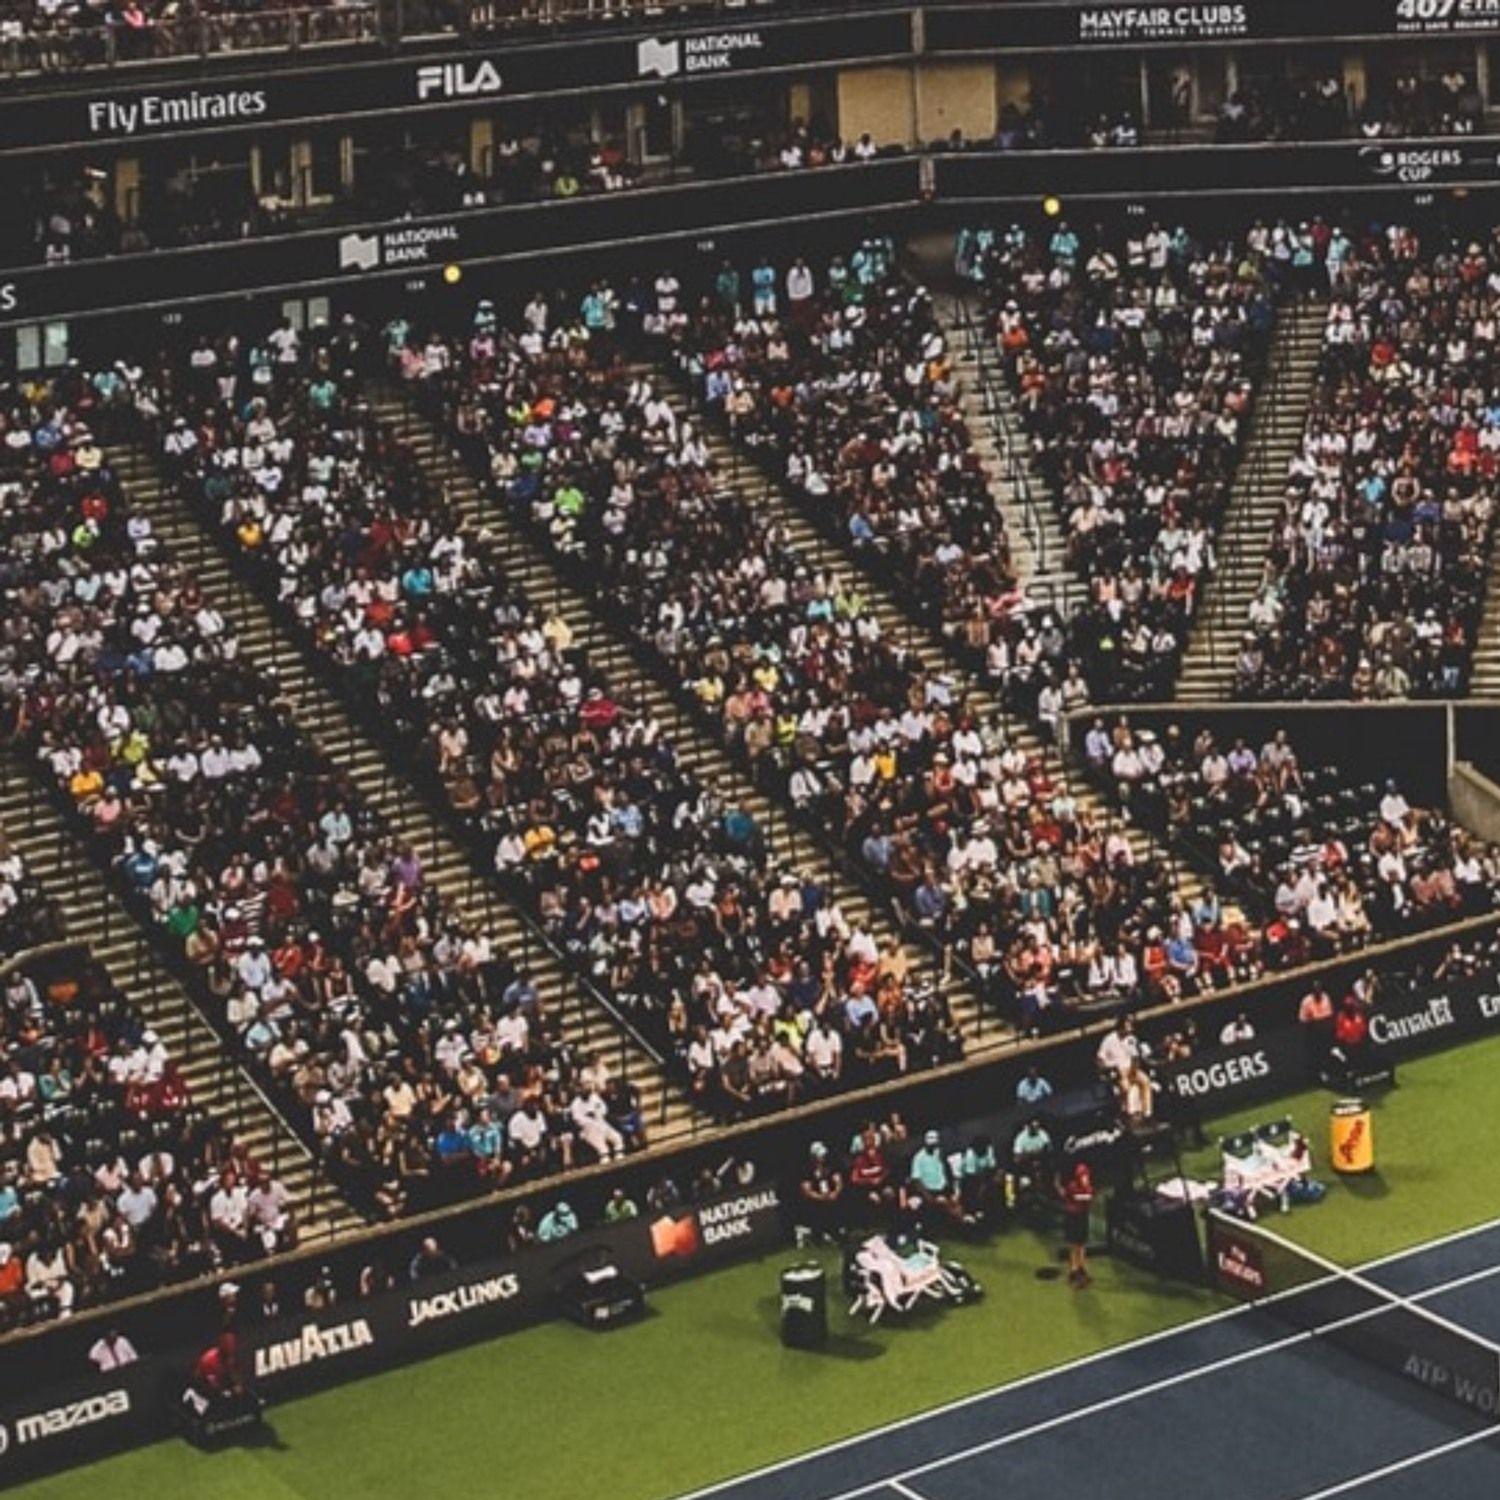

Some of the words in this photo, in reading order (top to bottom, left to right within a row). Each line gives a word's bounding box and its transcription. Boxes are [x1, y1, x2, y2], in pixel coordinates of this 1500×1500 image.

[1080, 8, 1170, 29] MAYFAIR
[1174, 5, 1247, 26] CLUBS
[685, 32, 762, 53] NATIONAL
[685, 52, 731, 71] BANK
[417, 60, 501, 98] FILA
[89, 102, 137, 132] Fly
[143, 91, 266, 125] Emirates
[1397, 150, 1462, 166] ROGERS
[1397, 166, 1432, 181] CUP
[383, 225, 459, 246] NATIONAL
[385, 245, 428, 264] BANK
[1369, 996, 1454, 1043] Canada
[1176, 1050, 1270, 1097] ROGERS
[700, 1189, 779, 1226] NATIONAL
[703, 1216, 752, 1245] BANK
[408, 1291, 461, 1327] JACK
[255, 1318, 374, 1377] LAVAZZA
[1404, 1354, 1449, 1387] ATP
